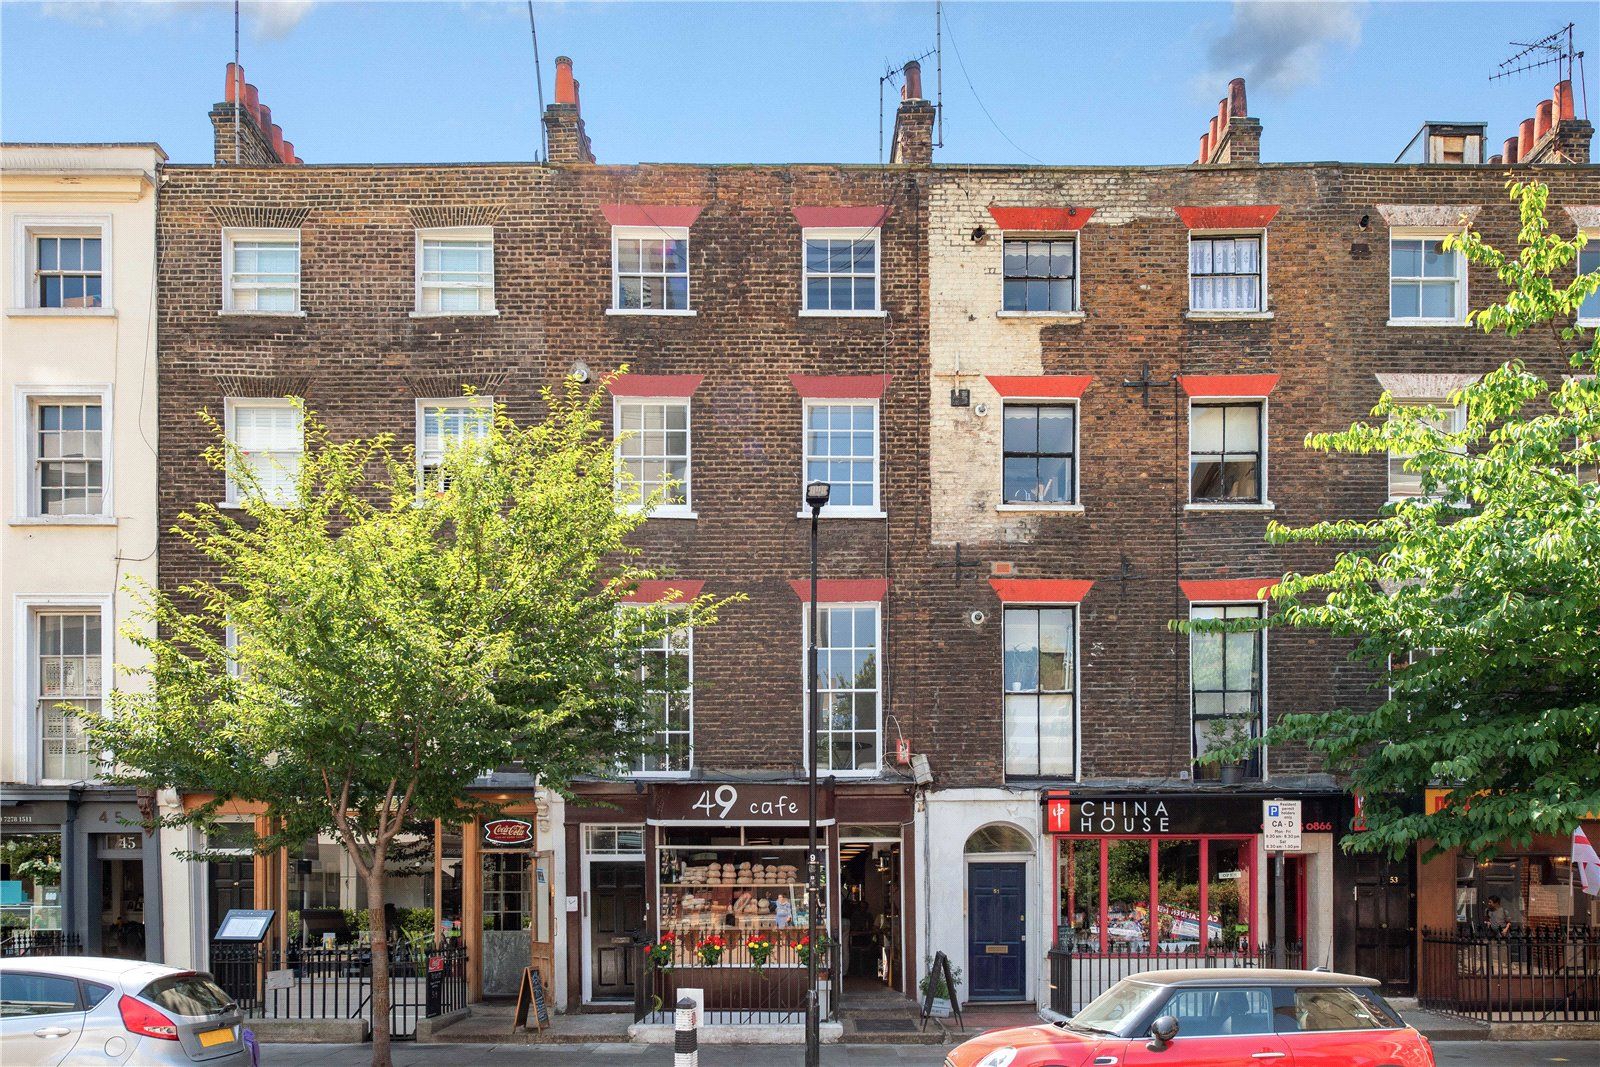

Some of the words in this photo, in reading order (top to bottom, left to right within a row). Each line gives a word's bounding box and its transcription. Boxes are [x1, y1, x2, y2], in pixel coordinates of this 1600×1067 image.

[692, 785, 738, 819] 49
[750, 795, 798, 817] cafe
[1080, 801, 1169, 817] CHINA
[493, 824, 525, 836] Coca-Cola
[1080, 817, 1169, 832] HOUSE
[1306, 822, 1332, 830] 0866
[119, 836, 136, 849] 45
[1389, 876, 1399, 884] 53
